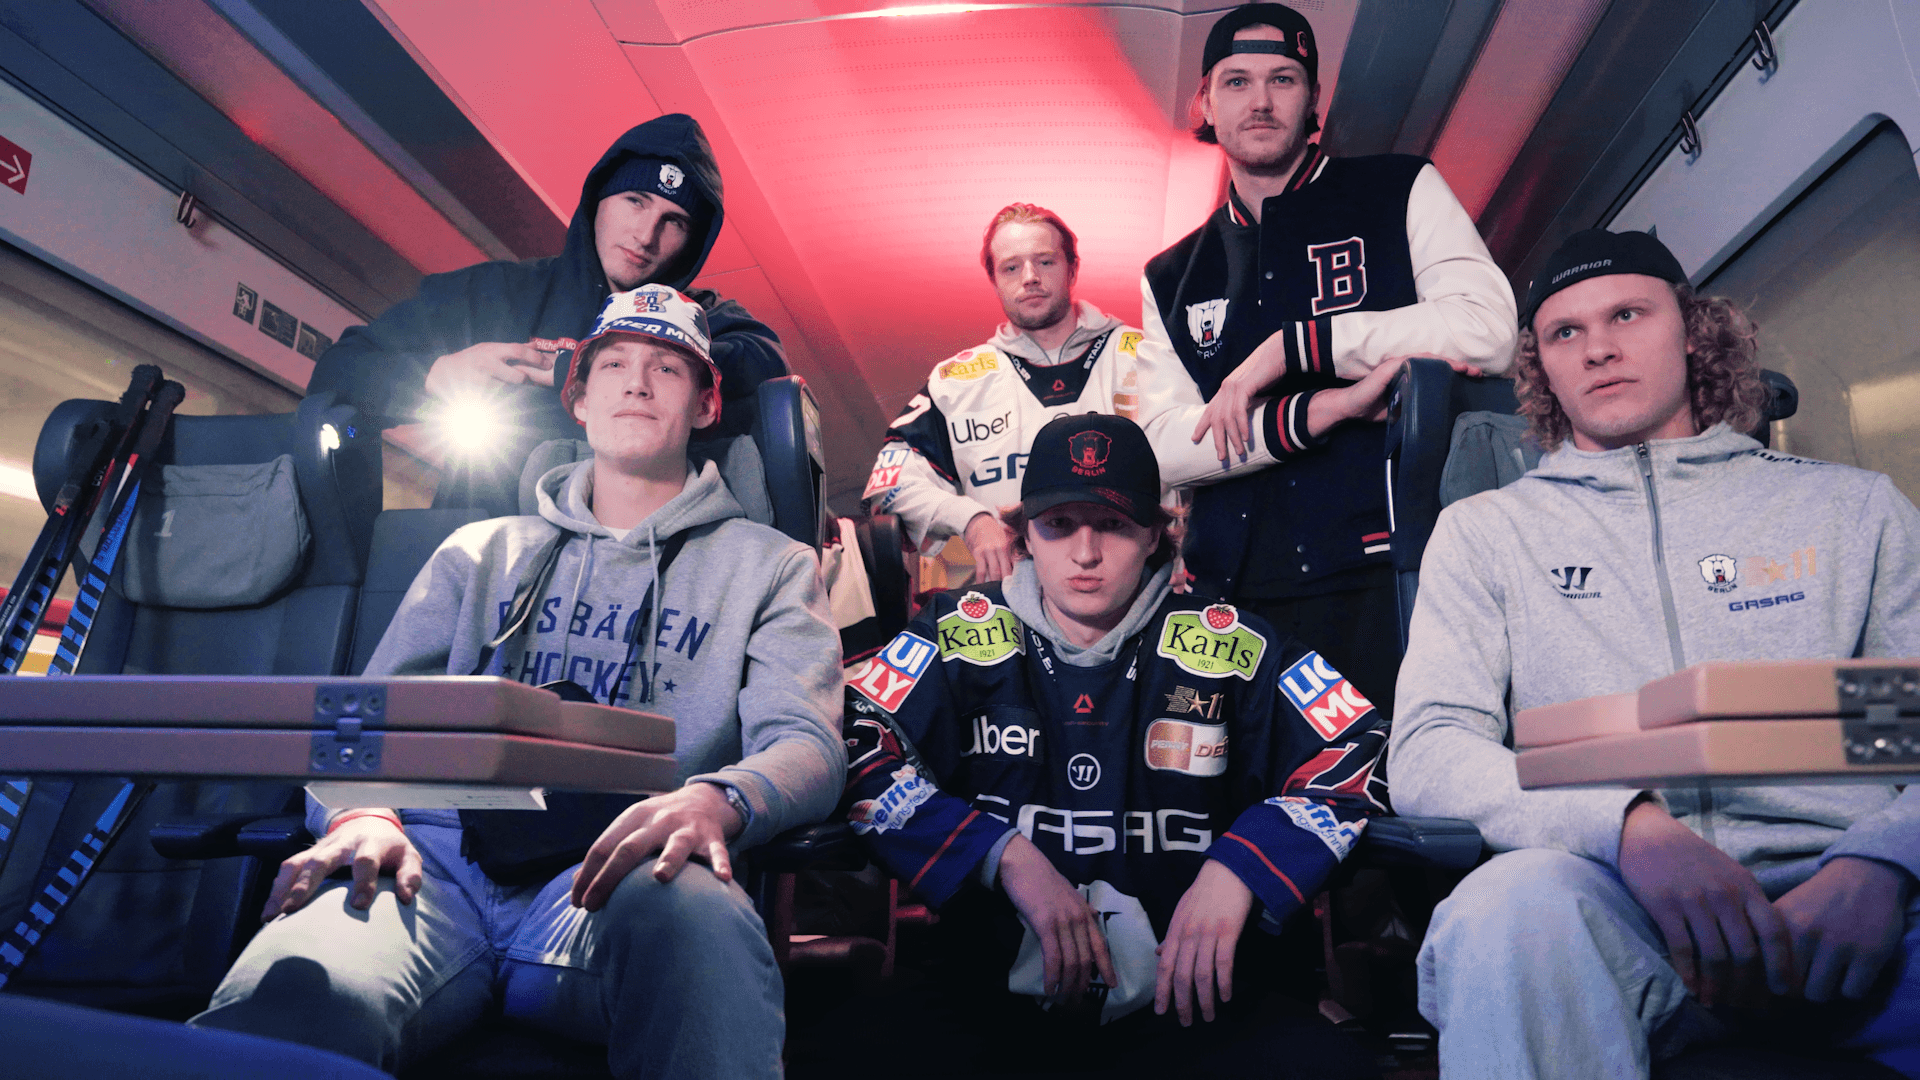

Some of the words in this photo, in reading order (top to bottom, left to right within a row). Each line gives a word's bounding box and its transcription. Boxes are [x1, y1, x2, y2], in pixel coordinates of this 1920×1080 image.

[1308, 236, 1367, 316] B
[1551, 258, 1613, 285] WARRIOR
[951, 410, 1012, 445] Uber
[1071, 465, 1106, 477] BERLIN
[154, 509, 176, 538] 1
[1707, 583, 1738, 594] BERLIN
[1728, 591, 1806, 612] GASAG
[938, 617, 1022, 654] Karls
[1166, 622, 1254, 670] Karls
[979, 648, 996, 659] 1921
[1197, 658, 1215, 670] 1921
